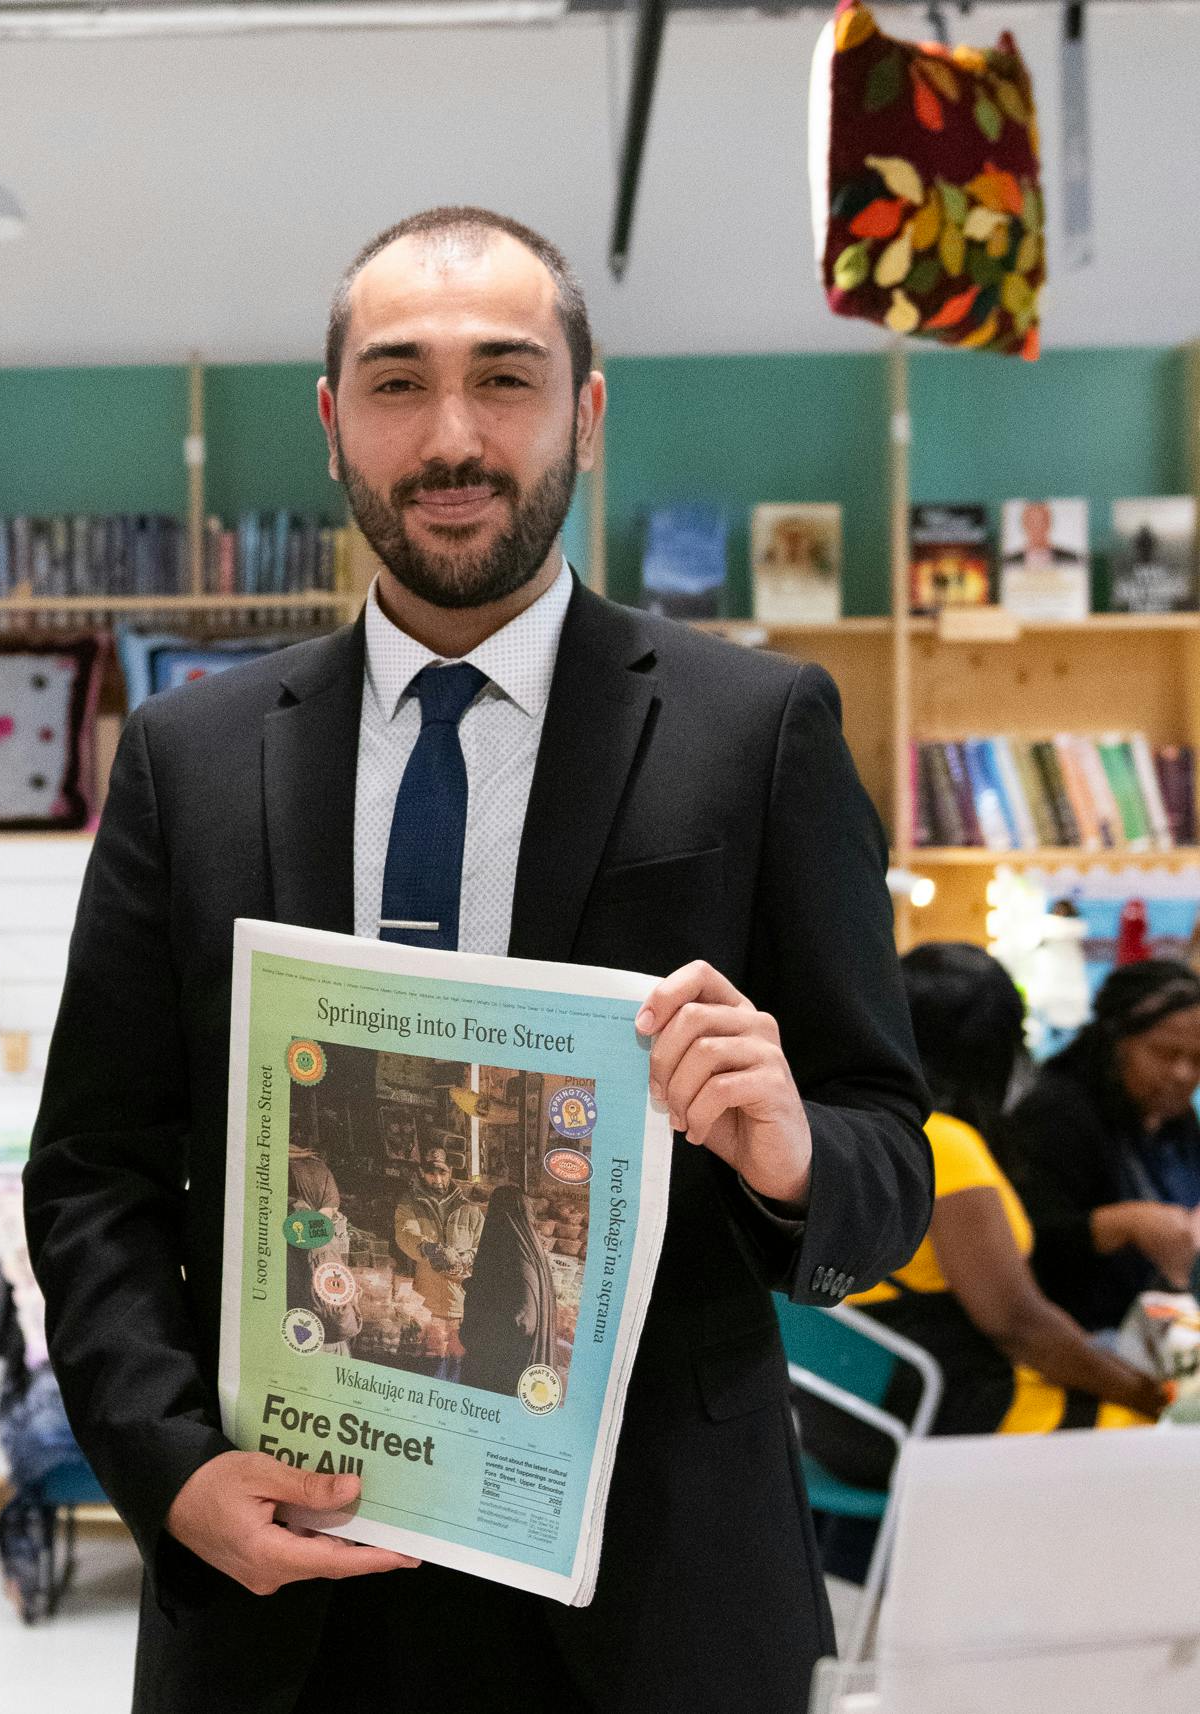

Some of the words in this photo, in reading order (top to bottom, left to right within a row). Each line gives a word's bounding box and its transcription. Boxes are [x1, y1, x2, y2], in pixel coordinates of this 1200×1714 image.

[317, 997, 411, 1038] Springing
[415, 1012, 456, 1038] into
[462, 1017, 507, 1045] Fore
[513, 1023, 575, 1054] Street
[257, 1064, 273, 1111] Street
[551, 1089, 594, 1113] SPRINGTIME
[256, 1114, 271, 1149] Fore
[255, 1153, 273, 1195] jidka
[550, 1155, 588, 1170] COMMUNITY
[610, 1157, 629, 1194] Fore
[257, 1195, 272, 1257] guuraya
[309, 1228, 328, 1238] LOCAL
[257, 1259, 268, 1285] soo
[252, 1287, 267, 1301] U
[300, 1309, 315, 1320] PHOTO
[550, 1375, 557, 1385] ON
[335, 1366, 405, 1403] Wskakując
[407, 1389, 424, 1405] na
[427, 1389, 458, 1413] Fore
[460, 1397, 501, 1424] Street
[524, 1399, 554, 1412] EDMONTON
[262, 1393, 331, 1439] Fore
[336, 1412, 435, 1466] Street
[485, 1461, 503, 1470] events
[504, 1465, 515, 1473] and
[516, 1468, 546, 1482] happenings
[547, 1477, 566, 1486] around
[486, 1451, 499, 1459] Find
[508, 1457, 524, 1466] about
[533, 1463, 548, 1472] latest
[548, 1467, 568, 1478] cultural
[482, 1488, 500, 1498] Edition
[483, 1479, 500, 1490] Spring
[484, 1469, 497, 1477] Fore
[519, 1478, 536, 1488] Upper
[537, 1483, 564, 1495] Edmonton
